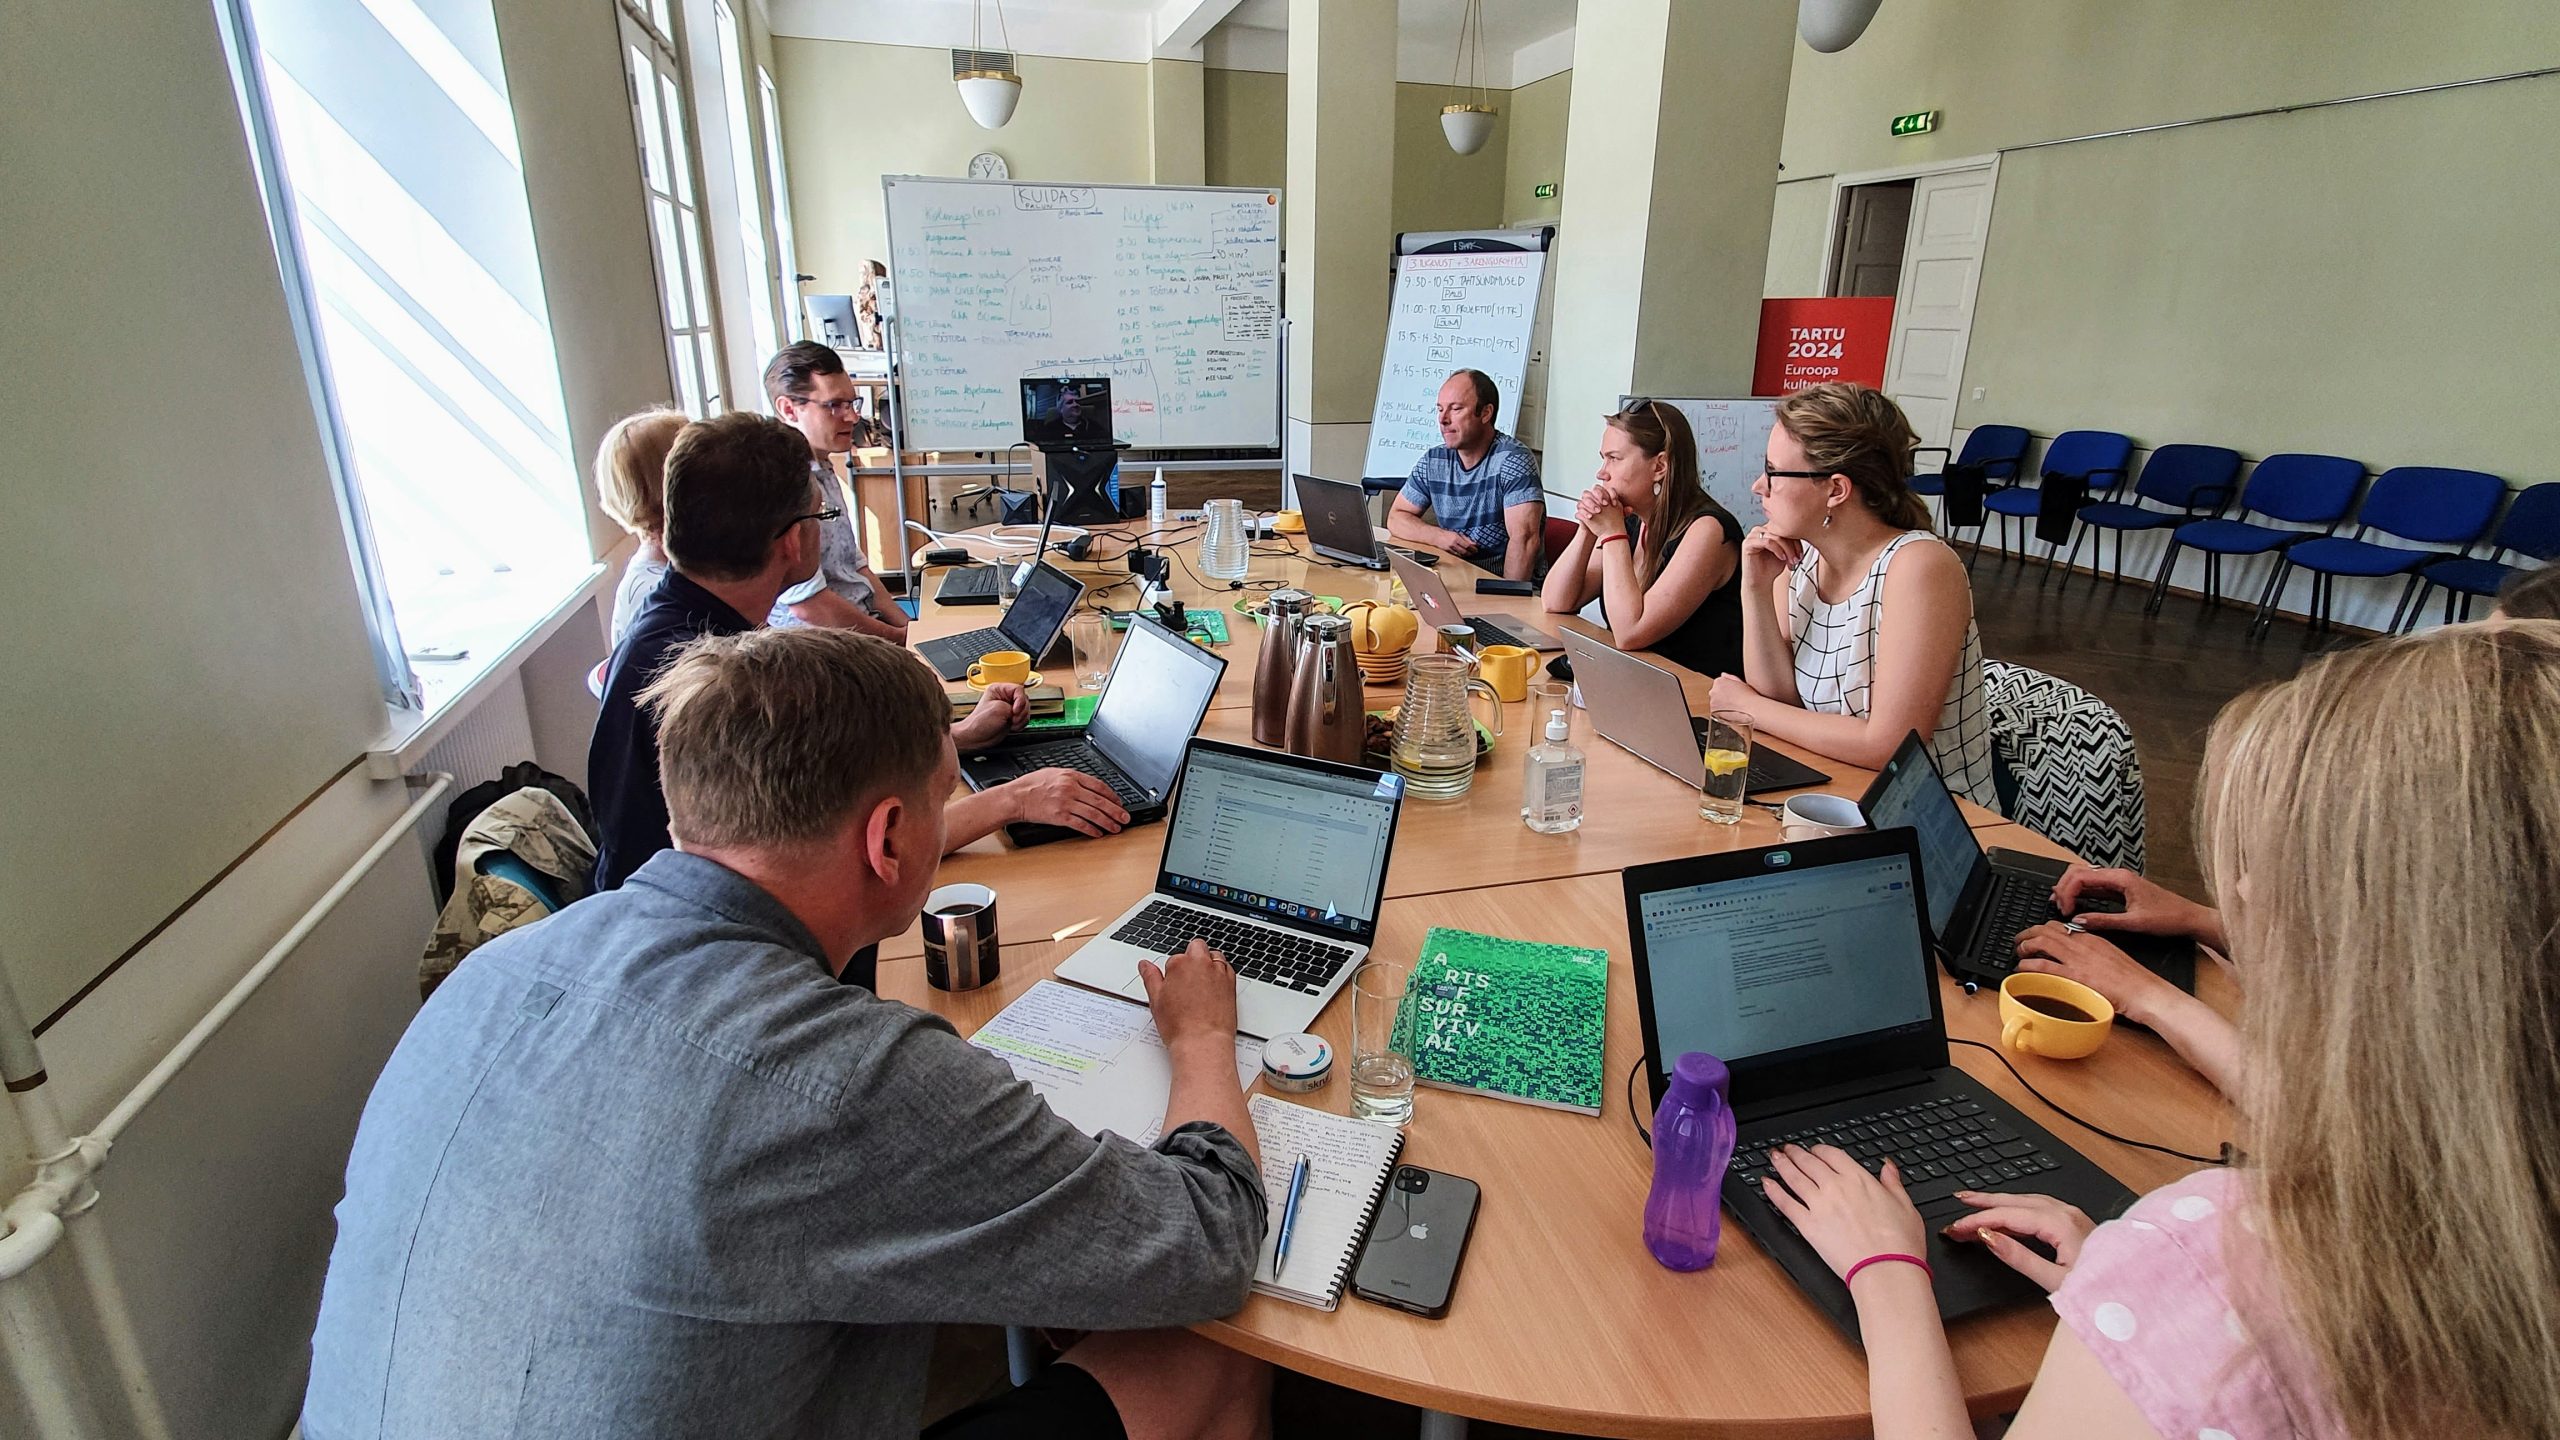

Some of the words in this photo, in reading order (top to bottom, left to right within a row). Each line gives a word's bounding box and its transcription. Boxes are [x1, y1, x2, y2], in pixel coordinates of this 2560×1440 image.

[1018, 188, 1088, 204] KUIDAS?
[1790, 327, 1846, 340] TARTU
[1787, 342, 1843, 359] 2024
[1785, 364, 1839, 378] Euroopa
[1433, 952, 1448, 966] A
[1444, 969, 1490, 988] RTS
[1419, 997, 1469, 1017] SUR
[1433, 1016, 1480, 1037] VIV
[1425, 1033, 1457, 1052] AL
